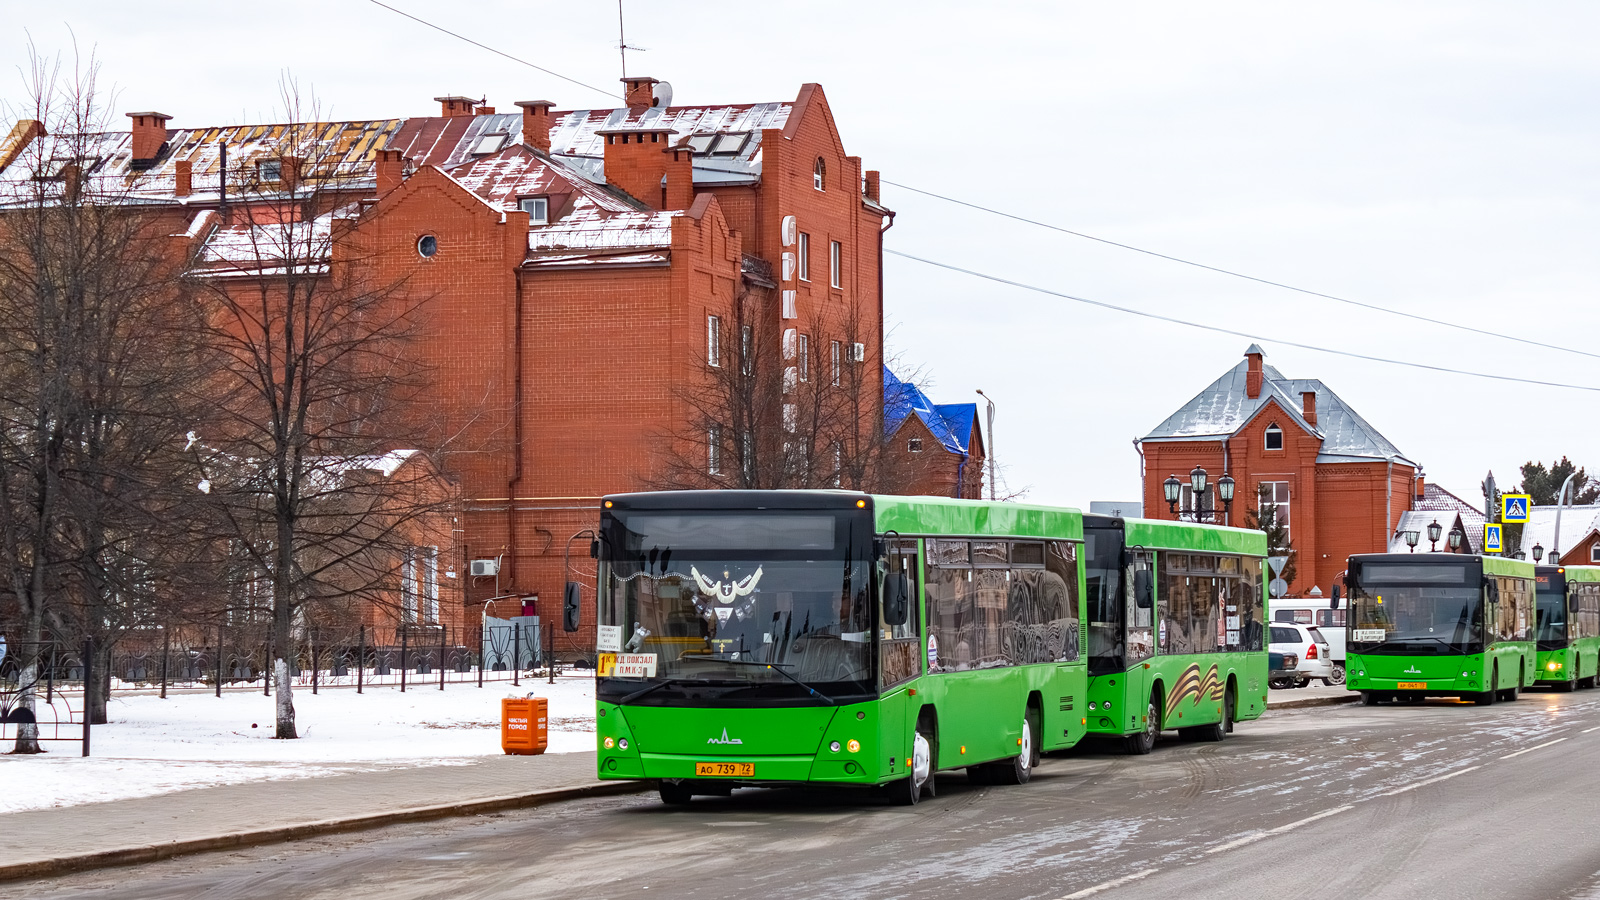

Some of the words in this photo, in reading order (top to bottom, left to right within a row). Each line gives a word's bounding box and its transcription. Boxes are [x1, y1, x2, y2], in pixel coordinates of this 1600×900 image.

[626, 655, 653, 664] ВОКЗАЛ
[700, 766, 713, 774] АО
[716, 764, 736, 775] 739
[741, 763, 751, 772] 72
